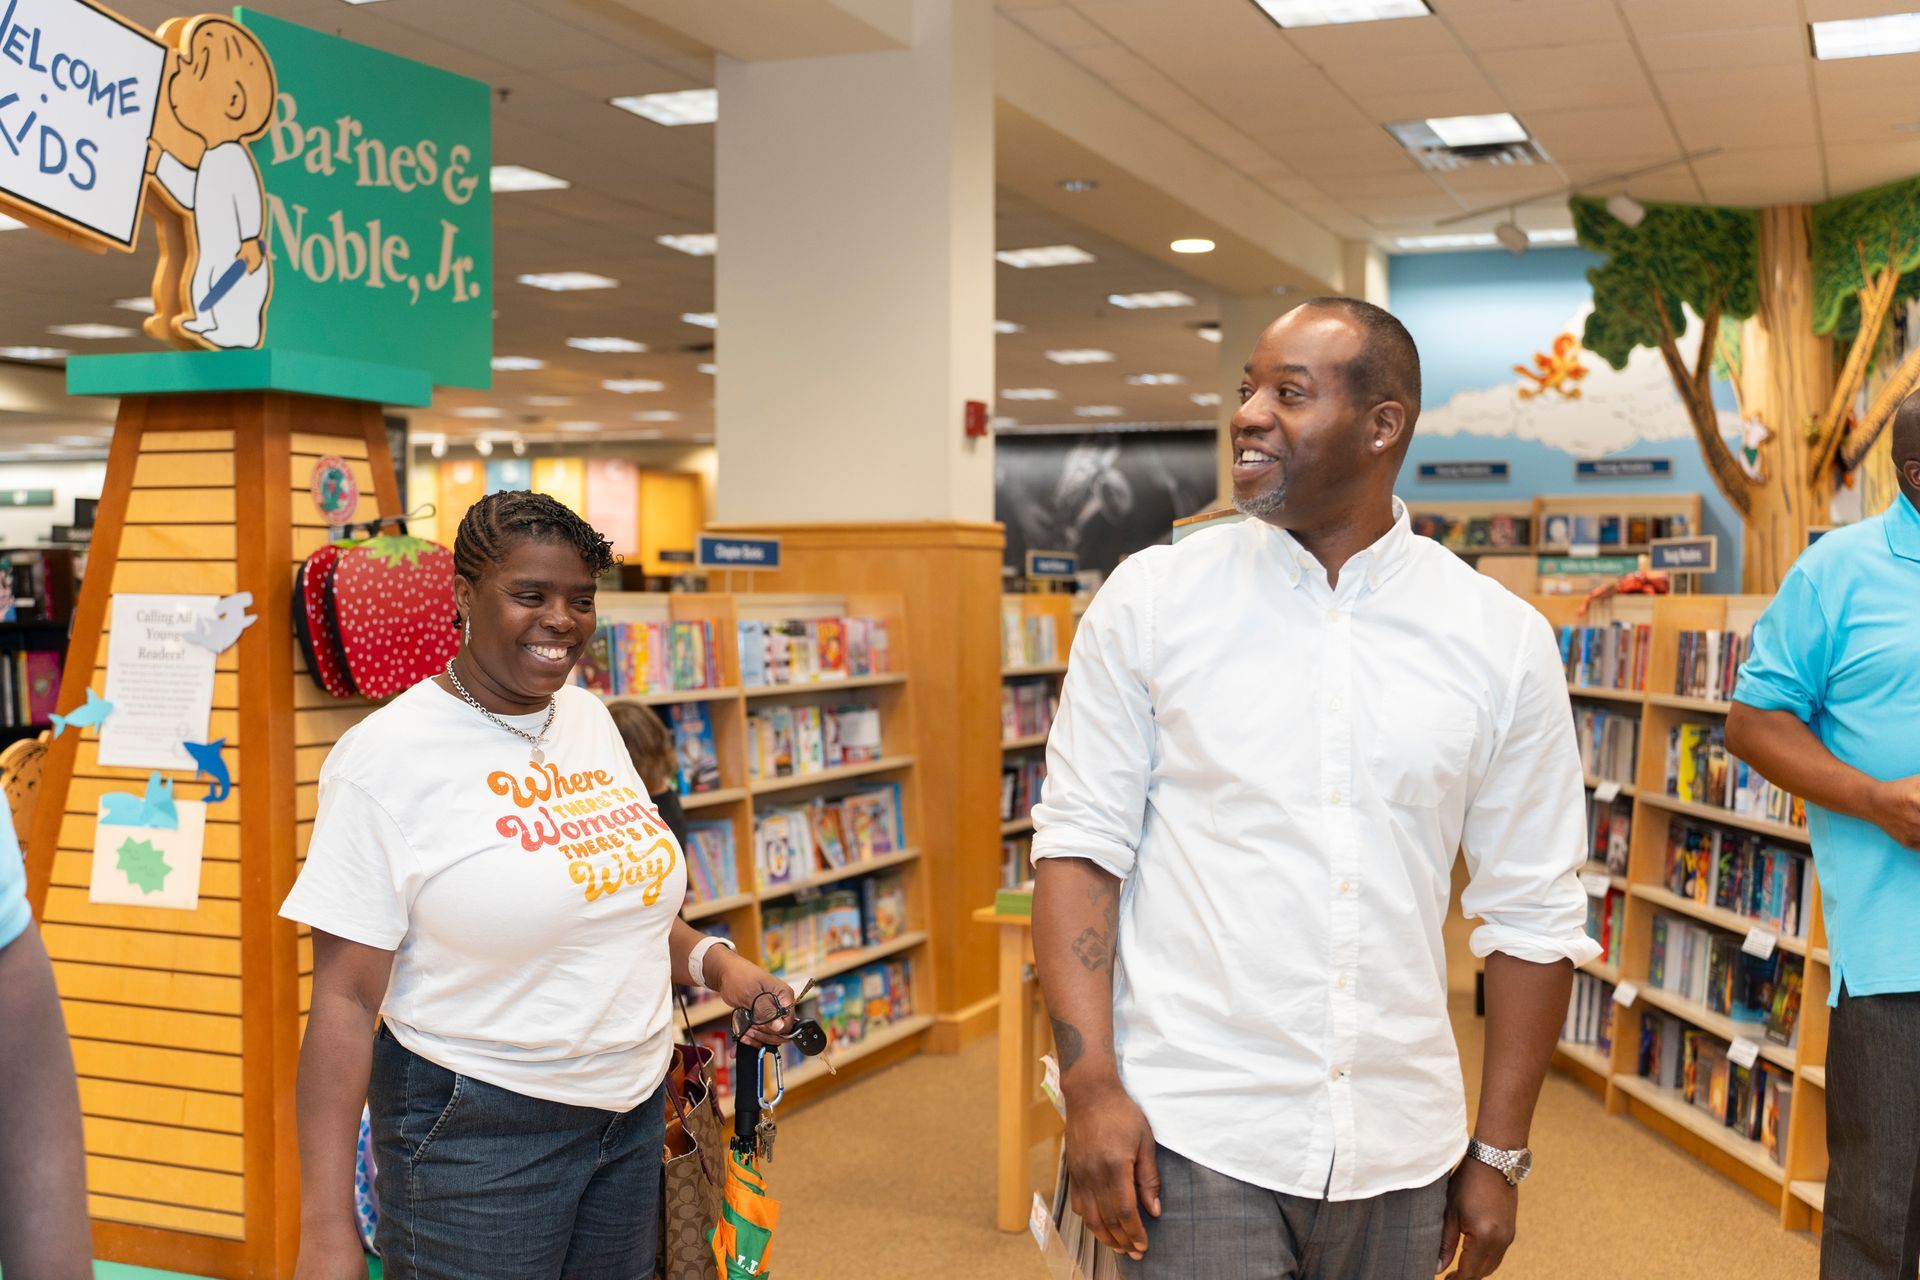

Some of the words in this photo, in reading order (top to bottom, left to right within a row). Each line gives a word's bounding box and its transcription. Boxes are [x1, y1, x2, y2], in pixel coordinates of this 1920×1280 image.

[269, 92, 438, 193] Barnes
[442, 144, 479, 205] &
[265, 192, 420, 306] Noble,
[425, 218, 480, 303] Jr.
[136, 610, 174, 625] Calling
[176, 611, 193, 624] All
[146, 628, 181, 642] Young
[138, 647, 185, 660] Readers!
[487, 761, 613, 808] Where
[552, 788, 625, 819] THERE'S
[623, 787, 639, 800] A
[496, 802, 669, 852] Woman
[558, 827, 642, 860] THERE'S
[642, 822, 658, 837] A
[568, 838, 676, 906] Way
